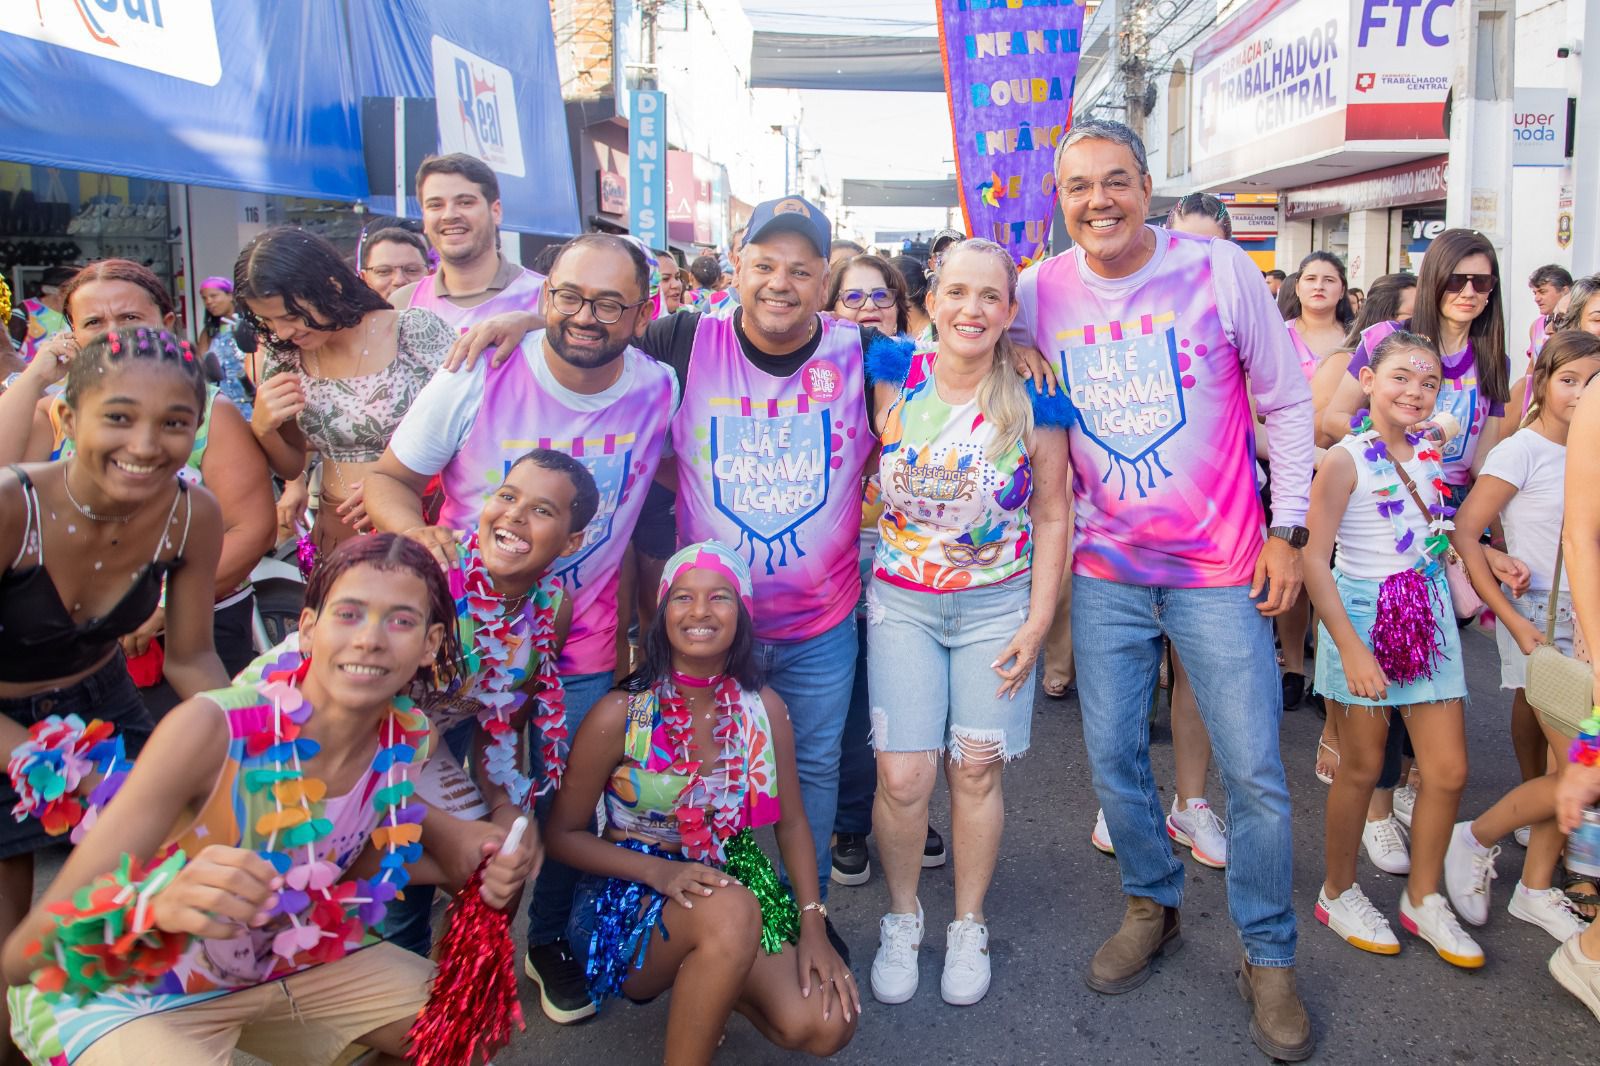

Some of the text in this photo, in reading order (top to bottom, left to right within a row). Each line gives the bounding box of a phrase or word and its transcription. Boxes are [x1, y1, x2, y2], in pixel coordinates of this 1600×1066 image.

[1357, 0, 1455, 47] FTC
[965, 29, 1080, 59] INFANTIL
[1220, 18, 1338, 113] TRABALHADOR
[1381, 76, 1448, 84] TRABALHADOR
[970, 77, 1063, 108] ROUBA
[1255, 67, 1337, 135] CENTRAL
[1407, 83, 1448, 91] CENTRAL
[1382, 172, 1414, 198] PAGANDO
[1414, 166, 1440, 193] MENOS
[245, 206, 259, 223] 116
[1087, 341, 1138, 382] JÁ É
[1071, 370, 1175, 411] CARNAVAL
[1092, 406, 1171, 437] LAGARTO
[741, 418, 791, 457] JÁ É
[714, 448, 823, 486] CARNAVAL
[903, 464, 968, 482] Assistência
[733, 484, 816, 514] LAGARTO
